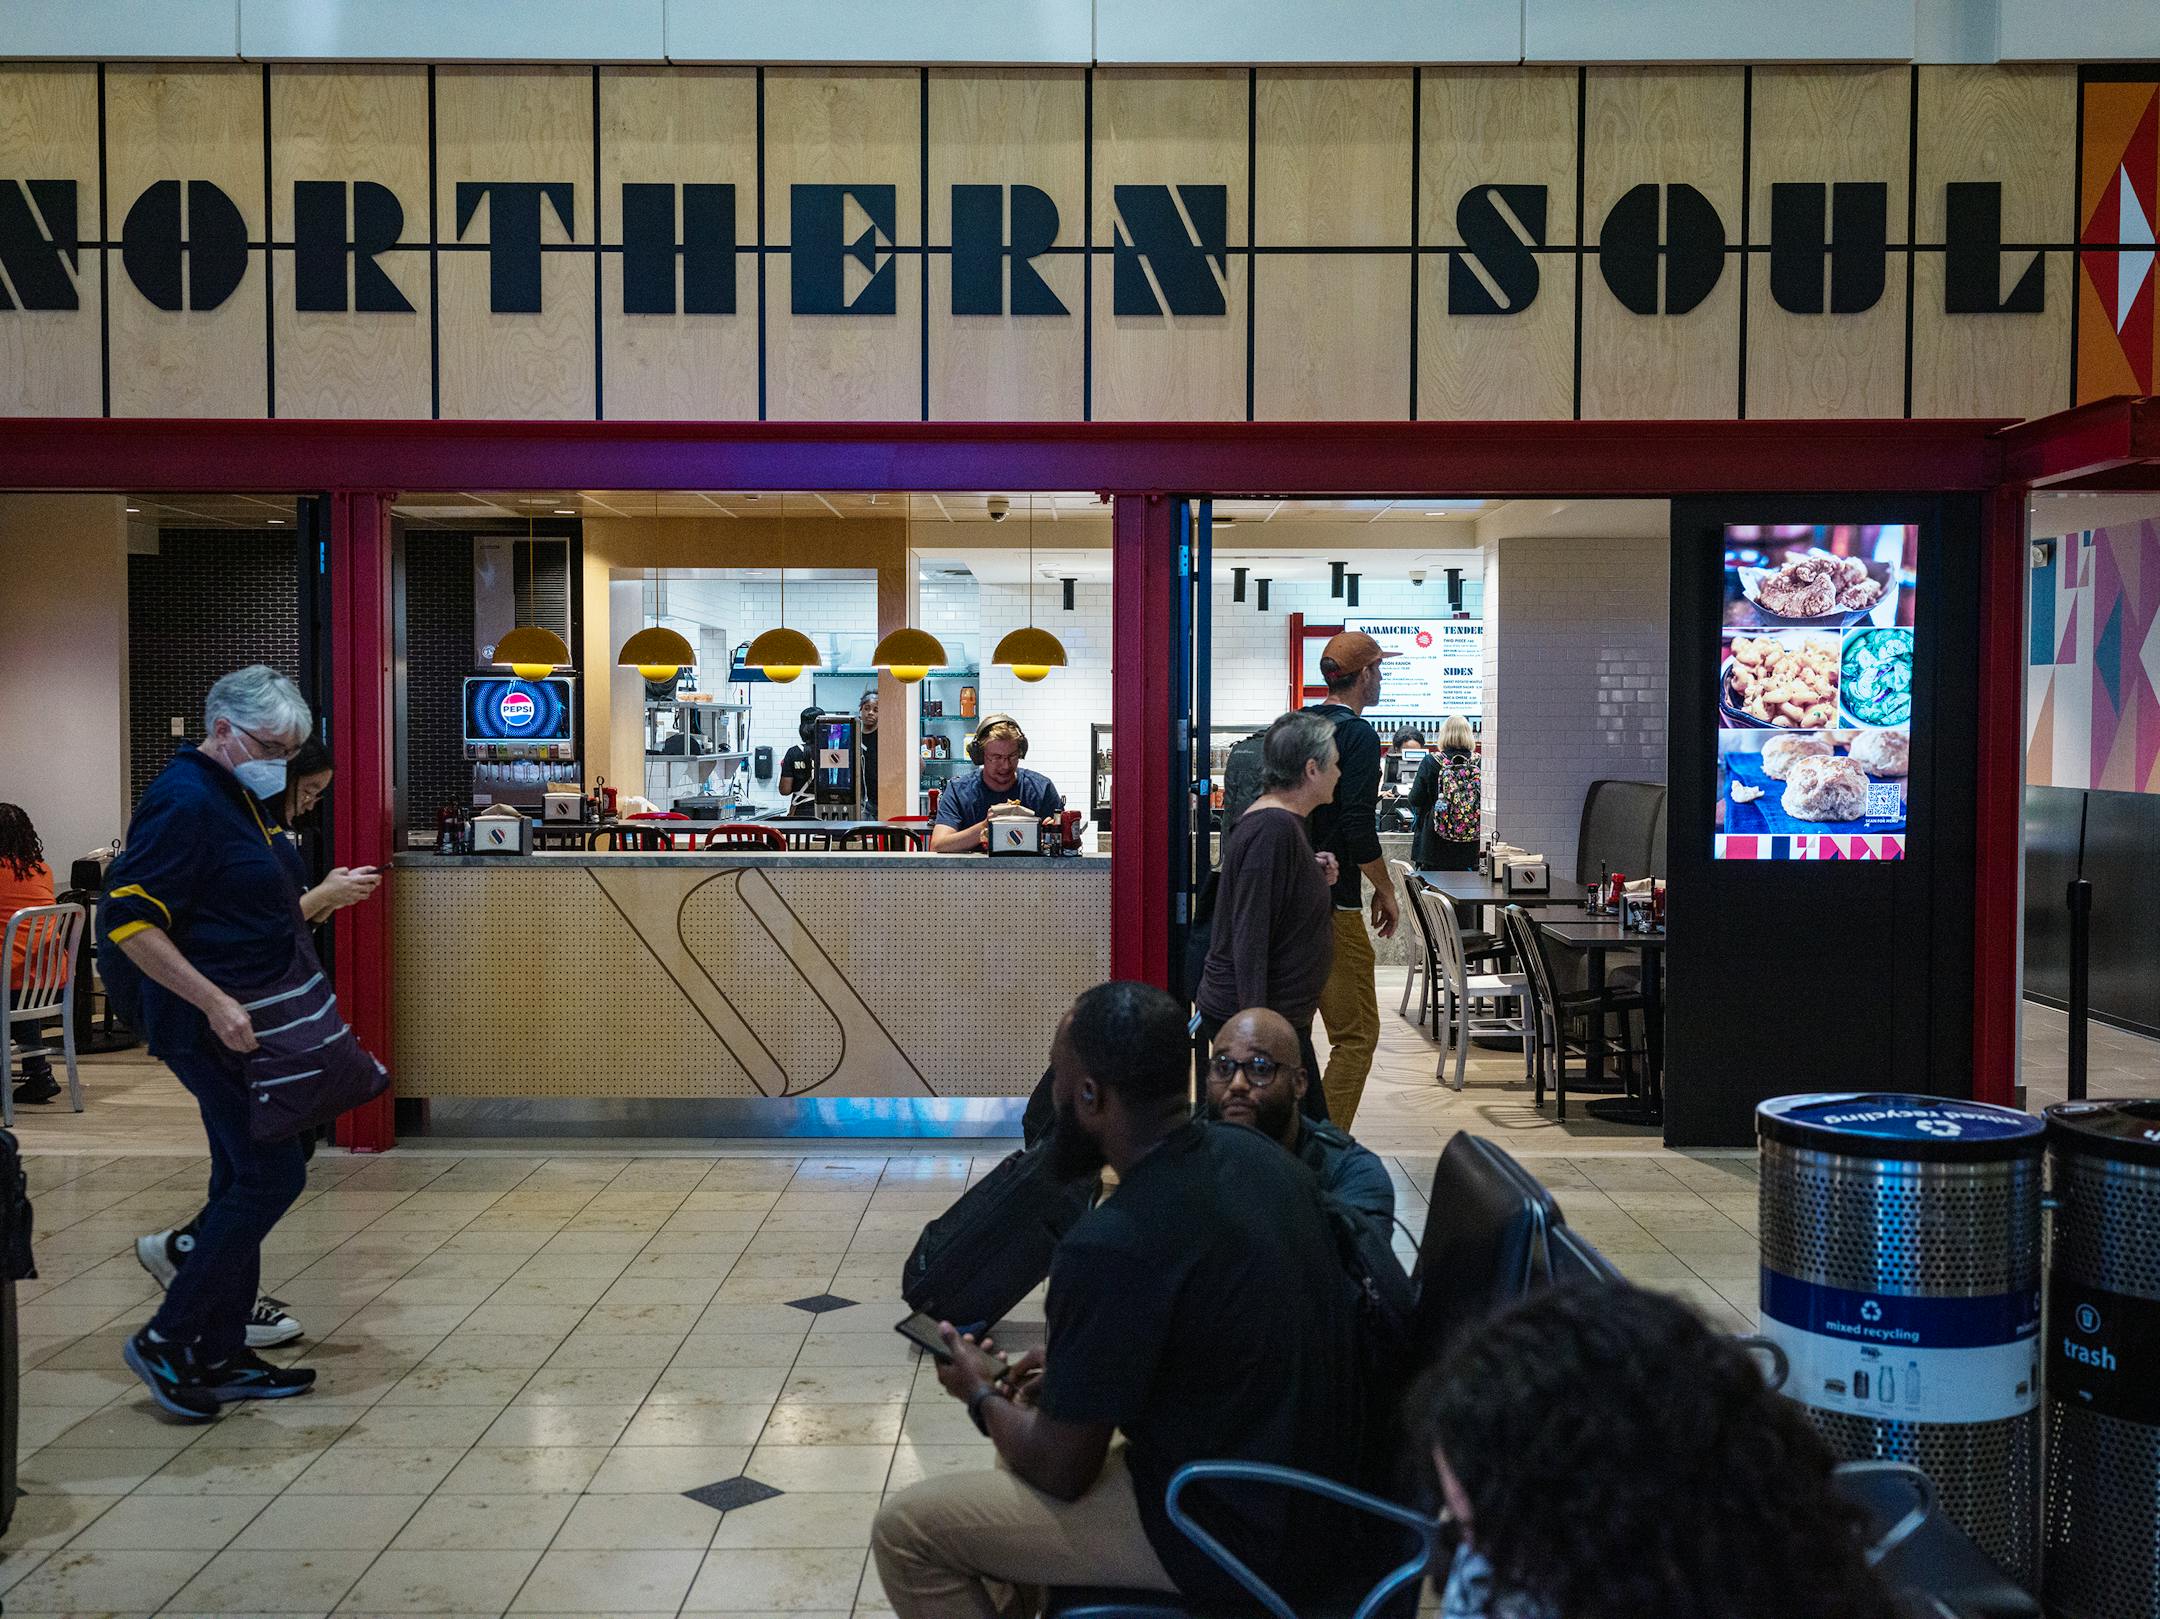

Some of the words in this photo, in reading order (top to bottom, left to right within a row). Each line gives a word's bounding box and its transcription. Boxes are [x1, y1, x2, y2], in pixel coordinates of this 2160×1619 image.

[0, 180, 1228, 316] NORTHERN
[1448, 181, 2045, 316] SOUL
[1360, 626, 1420, 635] SAMMICHES
[1443, 667, 1473, 676] SIDES
[503, 705, 532, 713] PEPSI
[1823, 1109, 1940, 1124] recycling
[1944, 1110, 2021, 1125] mixed
[1825, 1320, 1861, 1334] mixed
[1863, 1327, 1920, 1343] recycling
[2063, 1335, 2117, 1371] trash
